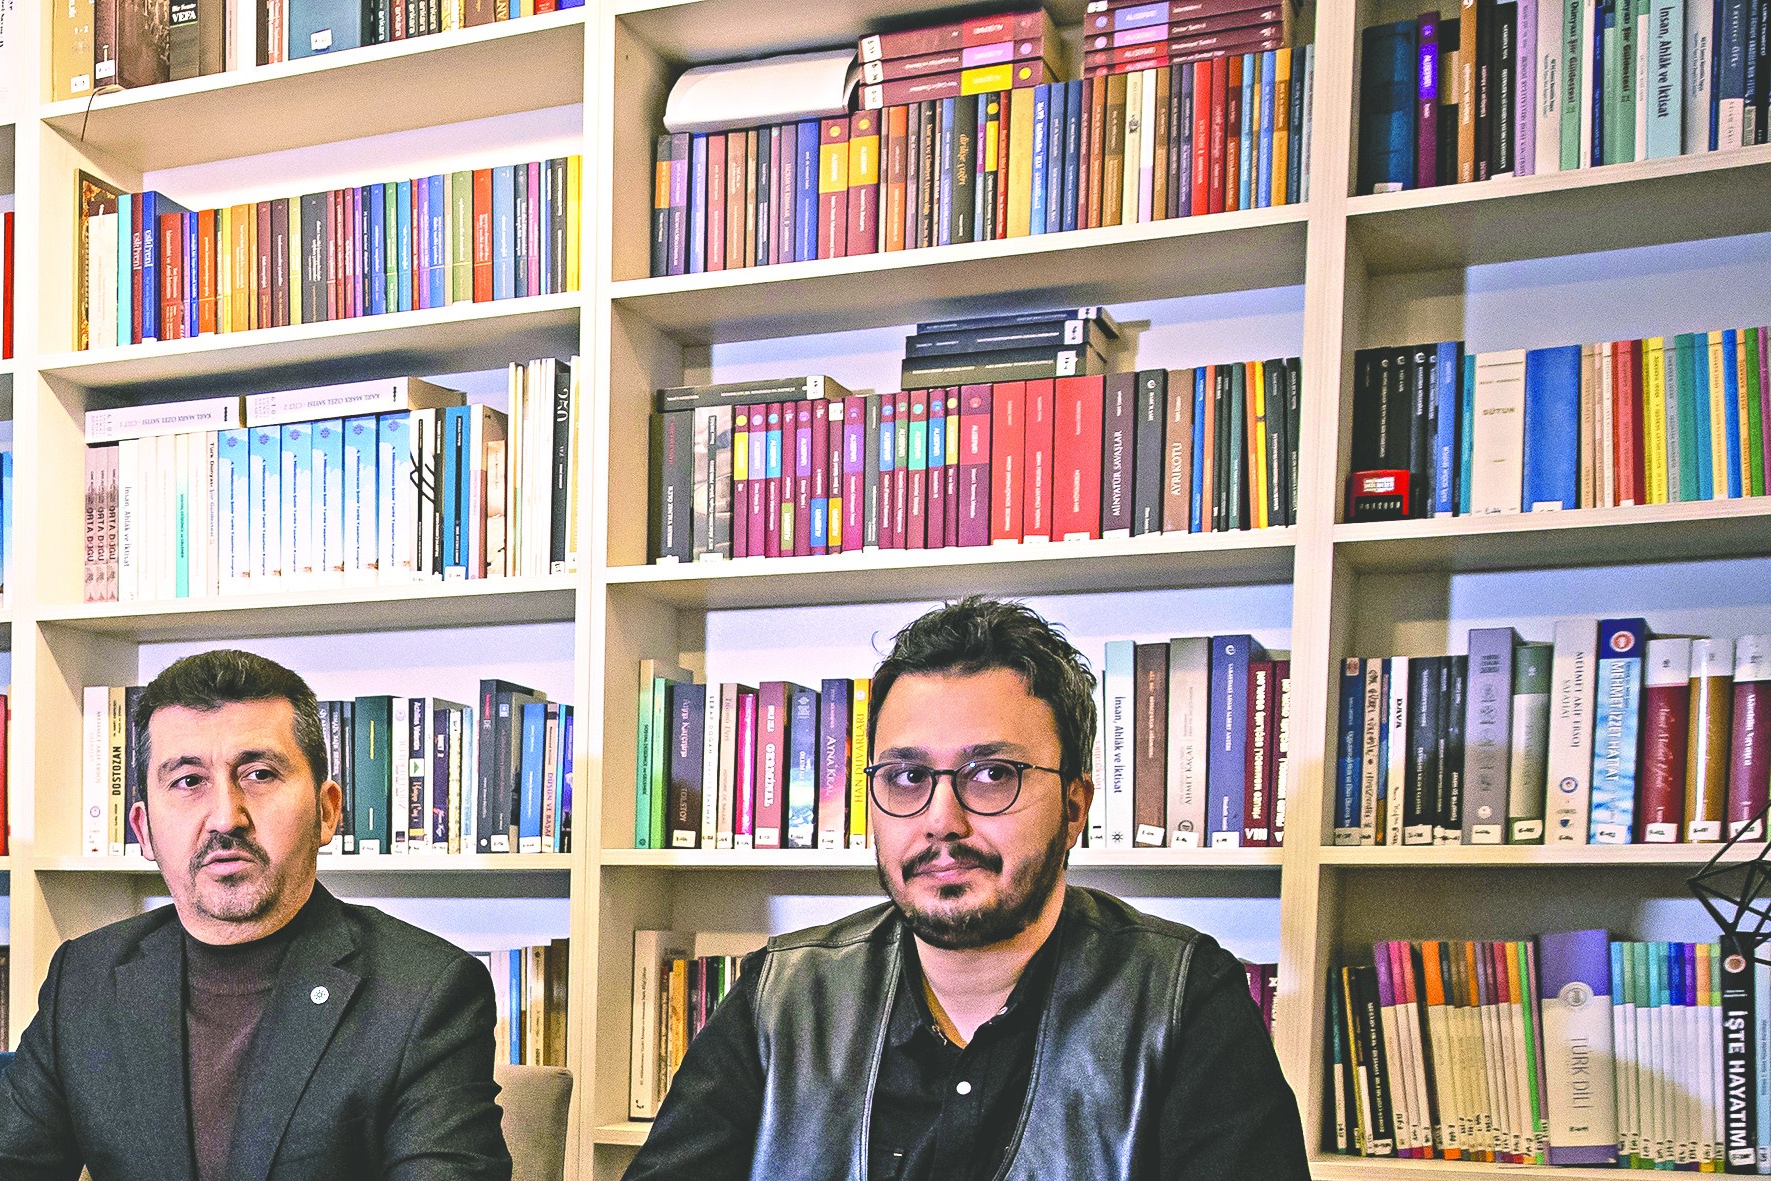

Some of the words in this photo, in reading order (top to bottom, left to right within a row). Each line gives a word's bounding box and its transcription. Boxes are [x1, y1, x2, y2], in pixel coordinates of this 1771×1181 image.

[378, 10, 386, 41] ankara
[394, 6, 402, 37] ankara
[408, 3, 416, 34] ankara
[1657, 6, 1675, 39] İnsan,
[1658, 40, 1672, 70] Ahlâk
[1658, 71, 1670, 84] ve
[1657, 84, 1674, 119] İktisat
[345, 394, 363, 404] MARX
[177, 413, 195, 422] MARX
[195, 412, 212, 421] KARL
[1111, 430, 1124, 470] SAVAŞLAR
[1169, 441, 1184, 496] AYRIKOTU
[1111, 471, 1125, 516] MİNYATÜR
[86, 507, 95, 533] ORTA
[109, 505, 117, 531] ORTA
[124, 533, 130, 542] ve
[1607, 661, 1625, 708] MEHMET
[1113, 696, 1127, 724] İnsan,
[1606, 710, 1625, 739] İZZET
[855, 713, 865, 776] DUVARLARI
[1113, 725, 1126, 751] Ahlâk
[112, 746, 122, 796] DOSTOZAN
[1113, 752, 1123, 763] ve
[1604, 740, 1620, 782] HATTAT
[763, 742, 776, 807] GERMİNAL
[1113, 765, 1127, 794] İktisat
[679, 788, 688, 822] TOLSTOY
[854, 779, 865, 803] HAN
[1244, 828, 1268, 840] VIII
[1723, 1010, 1749, 1054] İŞTE
[1571, 1037, 1592, 1076] TÜRK
[1572, 1081, 1595, 1109] DİLİ
[1727, 1060, 1747, 1147] HAYATIM
